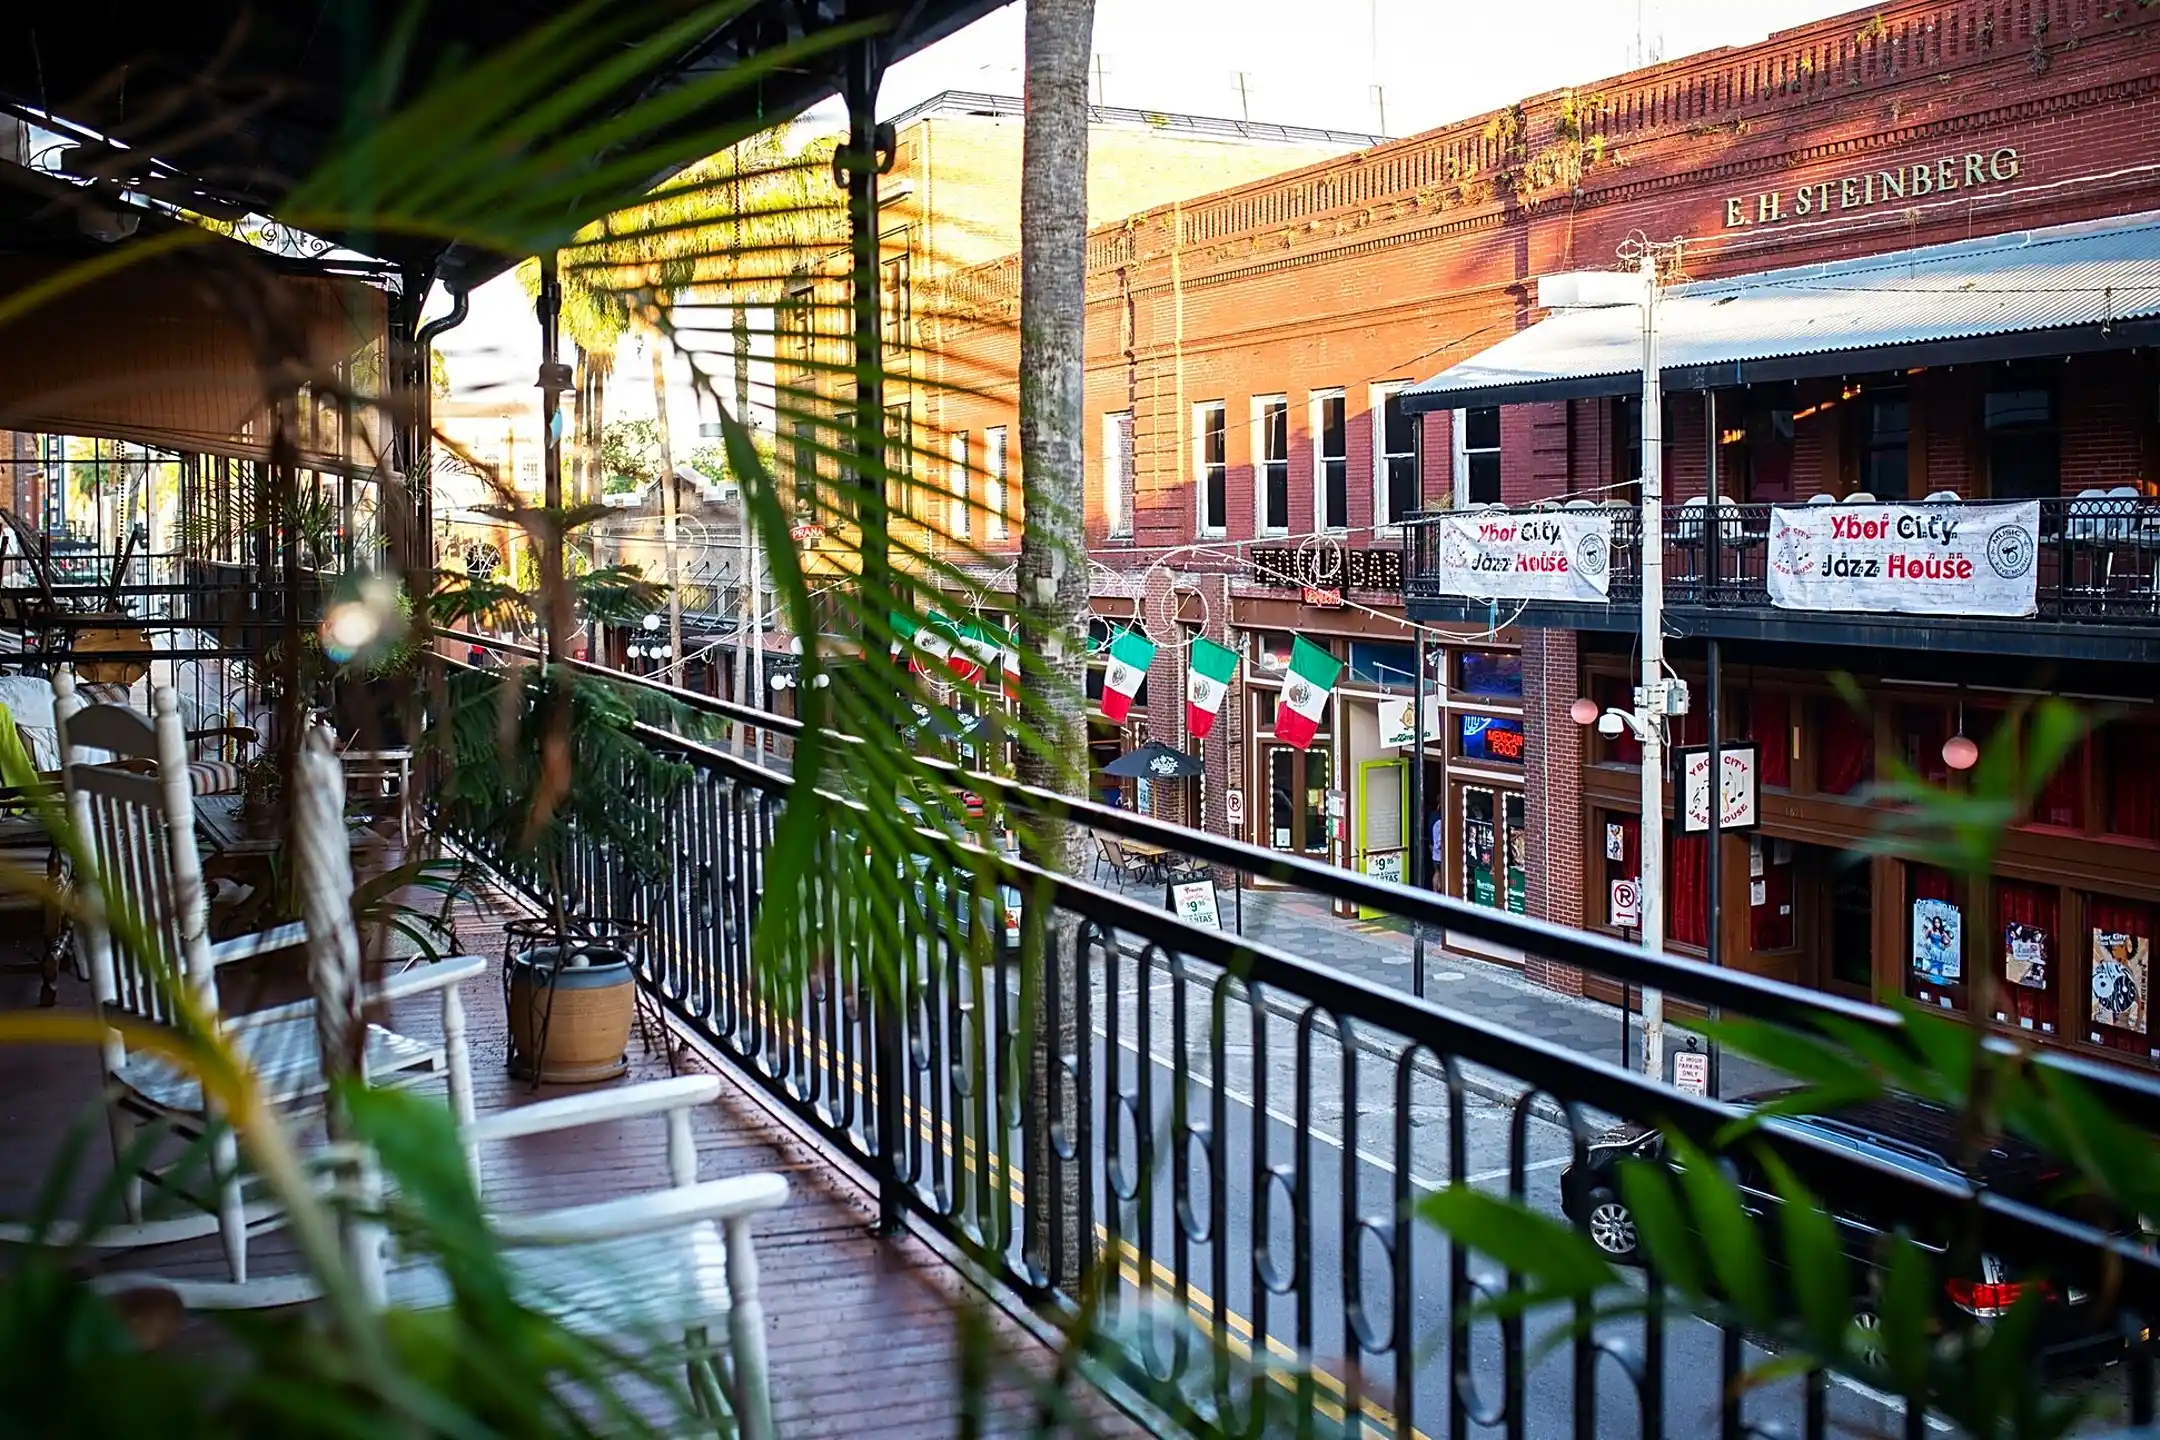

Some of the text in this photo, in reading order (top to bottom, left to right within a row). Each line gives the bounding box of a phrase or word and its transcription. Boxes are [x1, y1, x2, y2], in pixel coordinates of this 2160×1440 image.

[1726, 148, 2021, 228] E. H. STEINBERG
[792, 527, 825, 539] PRANA
[1479, 521, 1561, 545] Ybor City
[1831, 513, 1959, 546] Ybor City
[1993, 529, 2022, 544] MUSIC
[1351, 551, 1400, 588] BAR
[1471, 552, 1512, 572] Jazz
[1515, 552, 1569, 574] House
[1822, 554, 1973, 580] Jazz House
[1487, 730, 1523, 746] MEXICAN
[1493, 742, 1518, 756] FOOD
[1689, 756, 1749, 777] YBO CITY
[1688, 809, 1710, 825] JAZ
